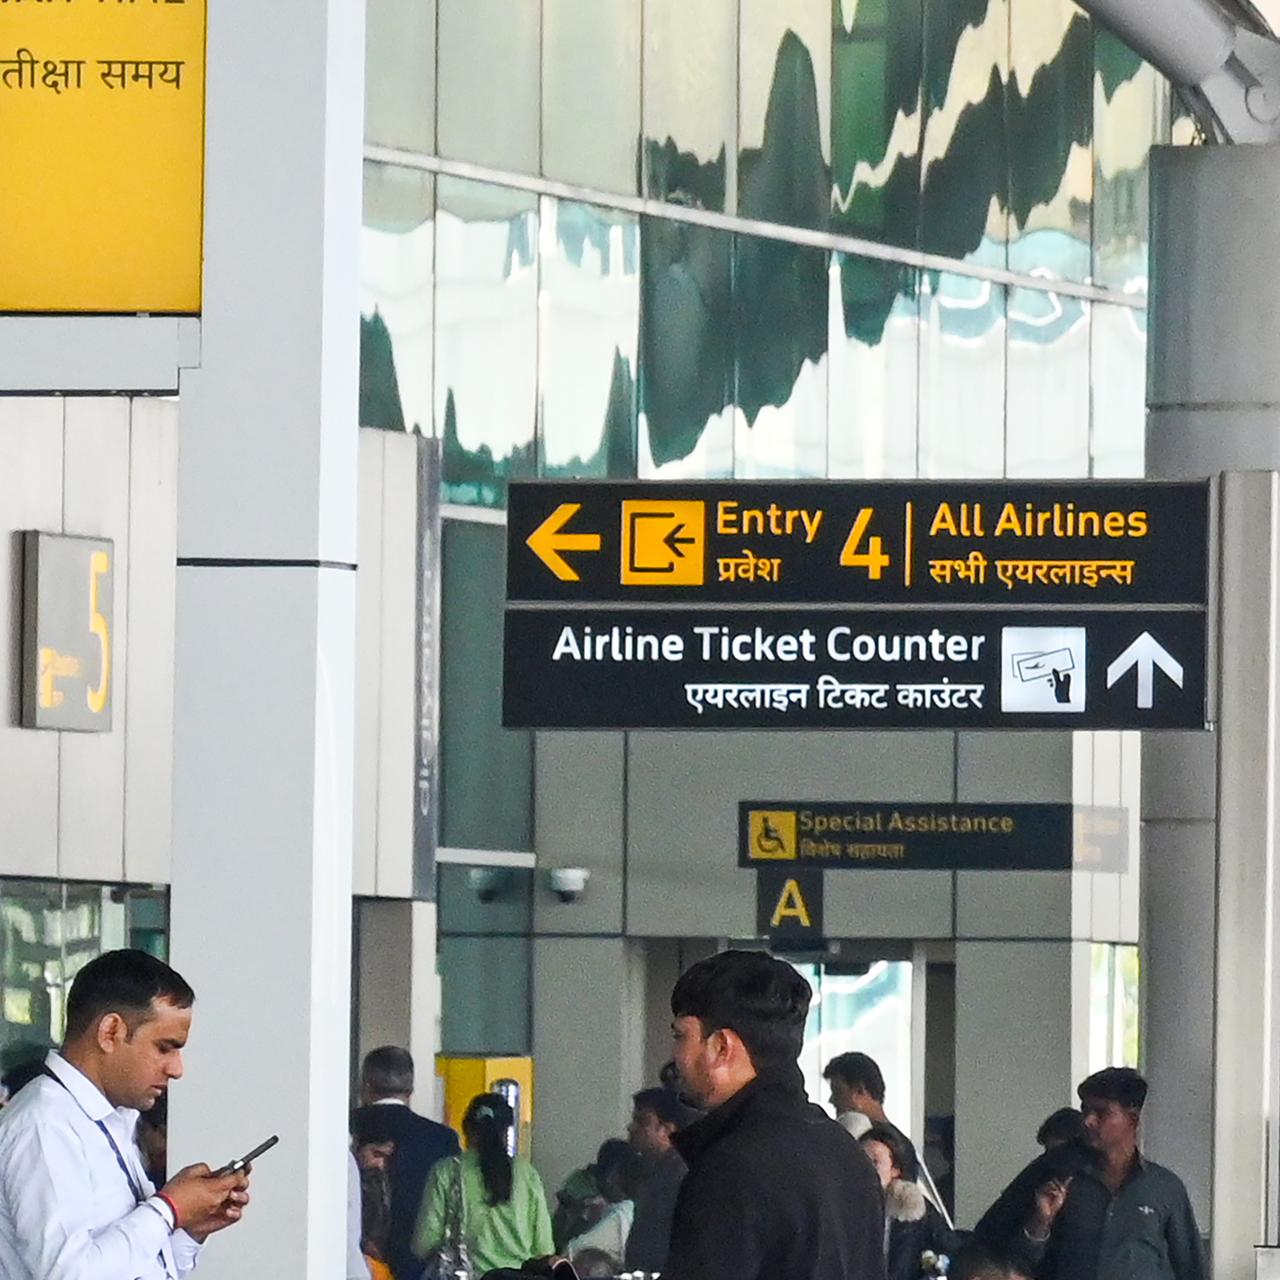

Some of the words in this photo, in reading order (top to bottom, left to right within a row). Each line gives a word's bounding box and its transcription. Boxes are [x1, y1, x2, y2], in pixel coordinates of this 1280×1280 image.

[0, 48, 86, 94] तीक्षा
[97, 60, 185, 90] समय
[716, 500, 823, 544] Entry
[840, 507, 890, 580] 4
[929, 502, 985, 537] All
[994, 502, 1148, 537] Airlines
[716, 549, 782, 583] प्रवेश
[928, 551, 987, 584] सभी
[995, 560, 1135, 590] एयरलाइन्स
[87, 551, 109, 713] 5
[552, 626, 684, 661] Airline
[693, 626, 816, 661] Ticket
[827, 626, 985, 661] Counter
[684, 683, 810, 714] एयरलाइन
[816, 675, 889, 708] टिकट
[896, 677, 985, 708] काउंटर
[800, 811, 883, 834] Special
[888, 811, 1014, 833] Assistance
[770, 878, 811, 928] A
